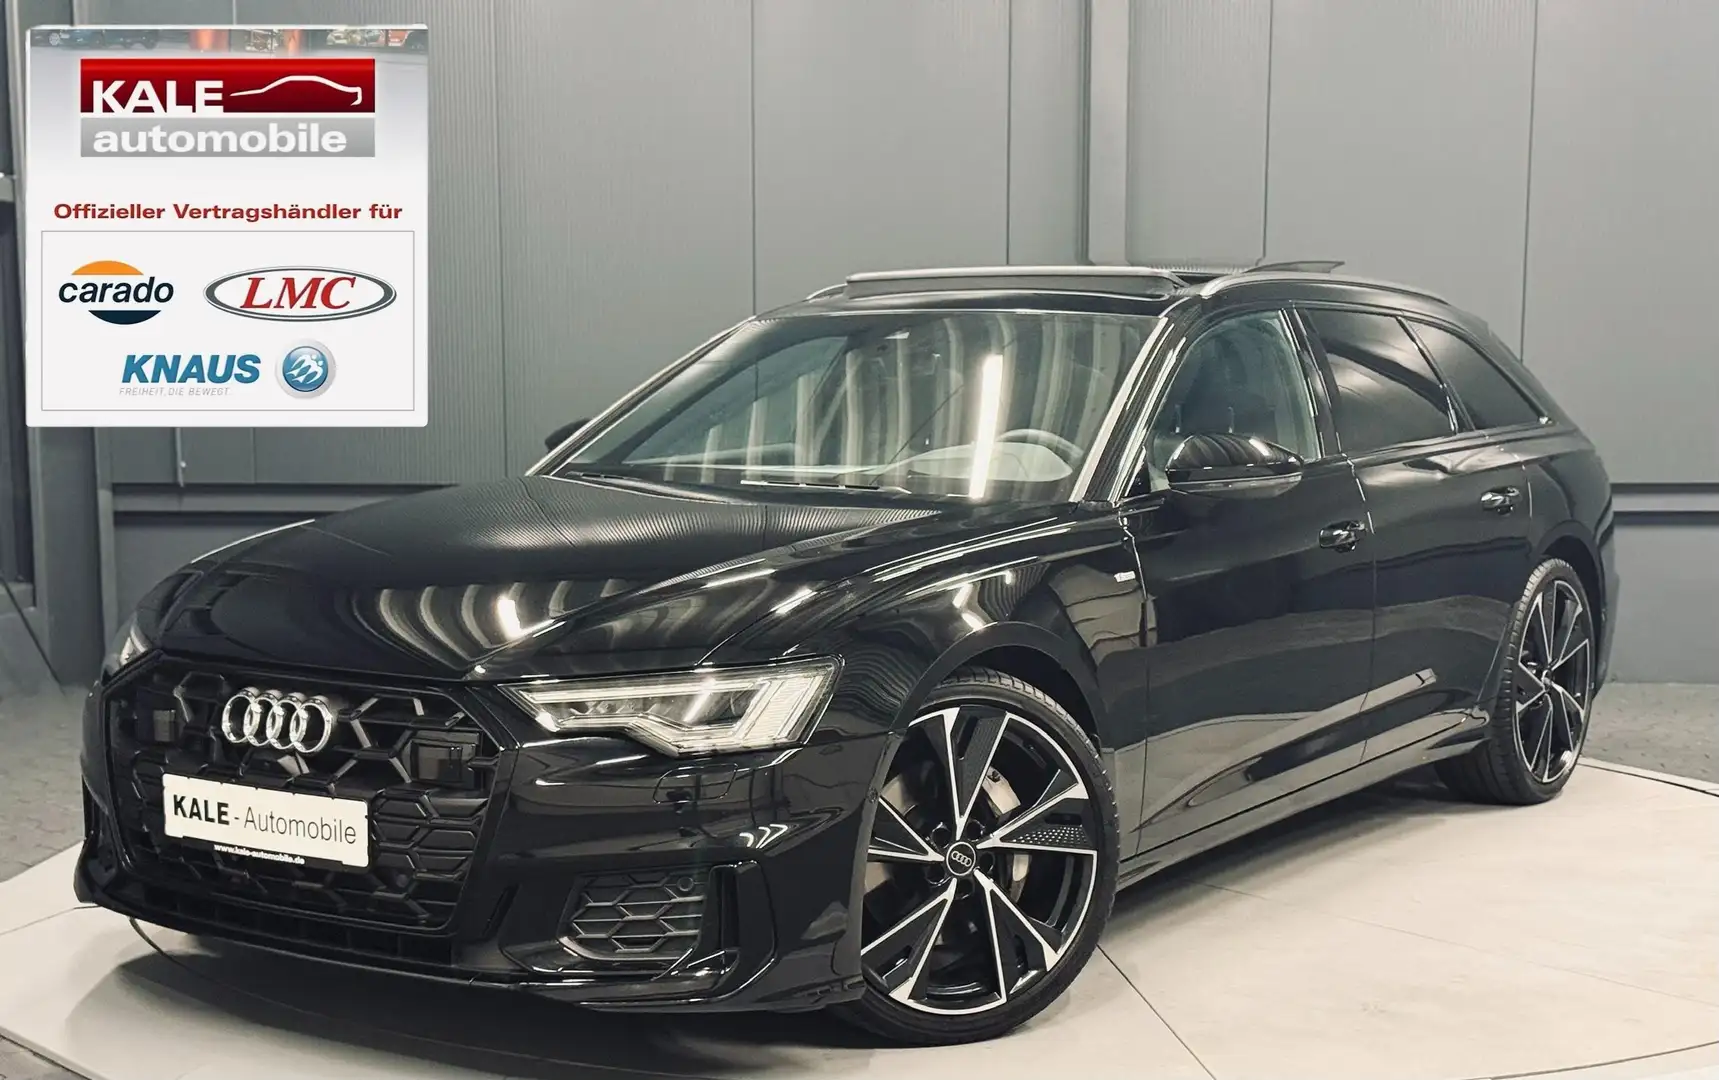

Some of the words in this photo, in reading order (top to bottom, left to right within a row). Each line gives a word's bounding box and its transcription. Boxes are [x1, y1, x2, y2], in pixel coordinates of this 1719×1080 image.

[173, 794, 230, 826] KALE
[244, 806, 356, 845] Automobile
[213, 843, 306, 865] www.kale-automobile.de
